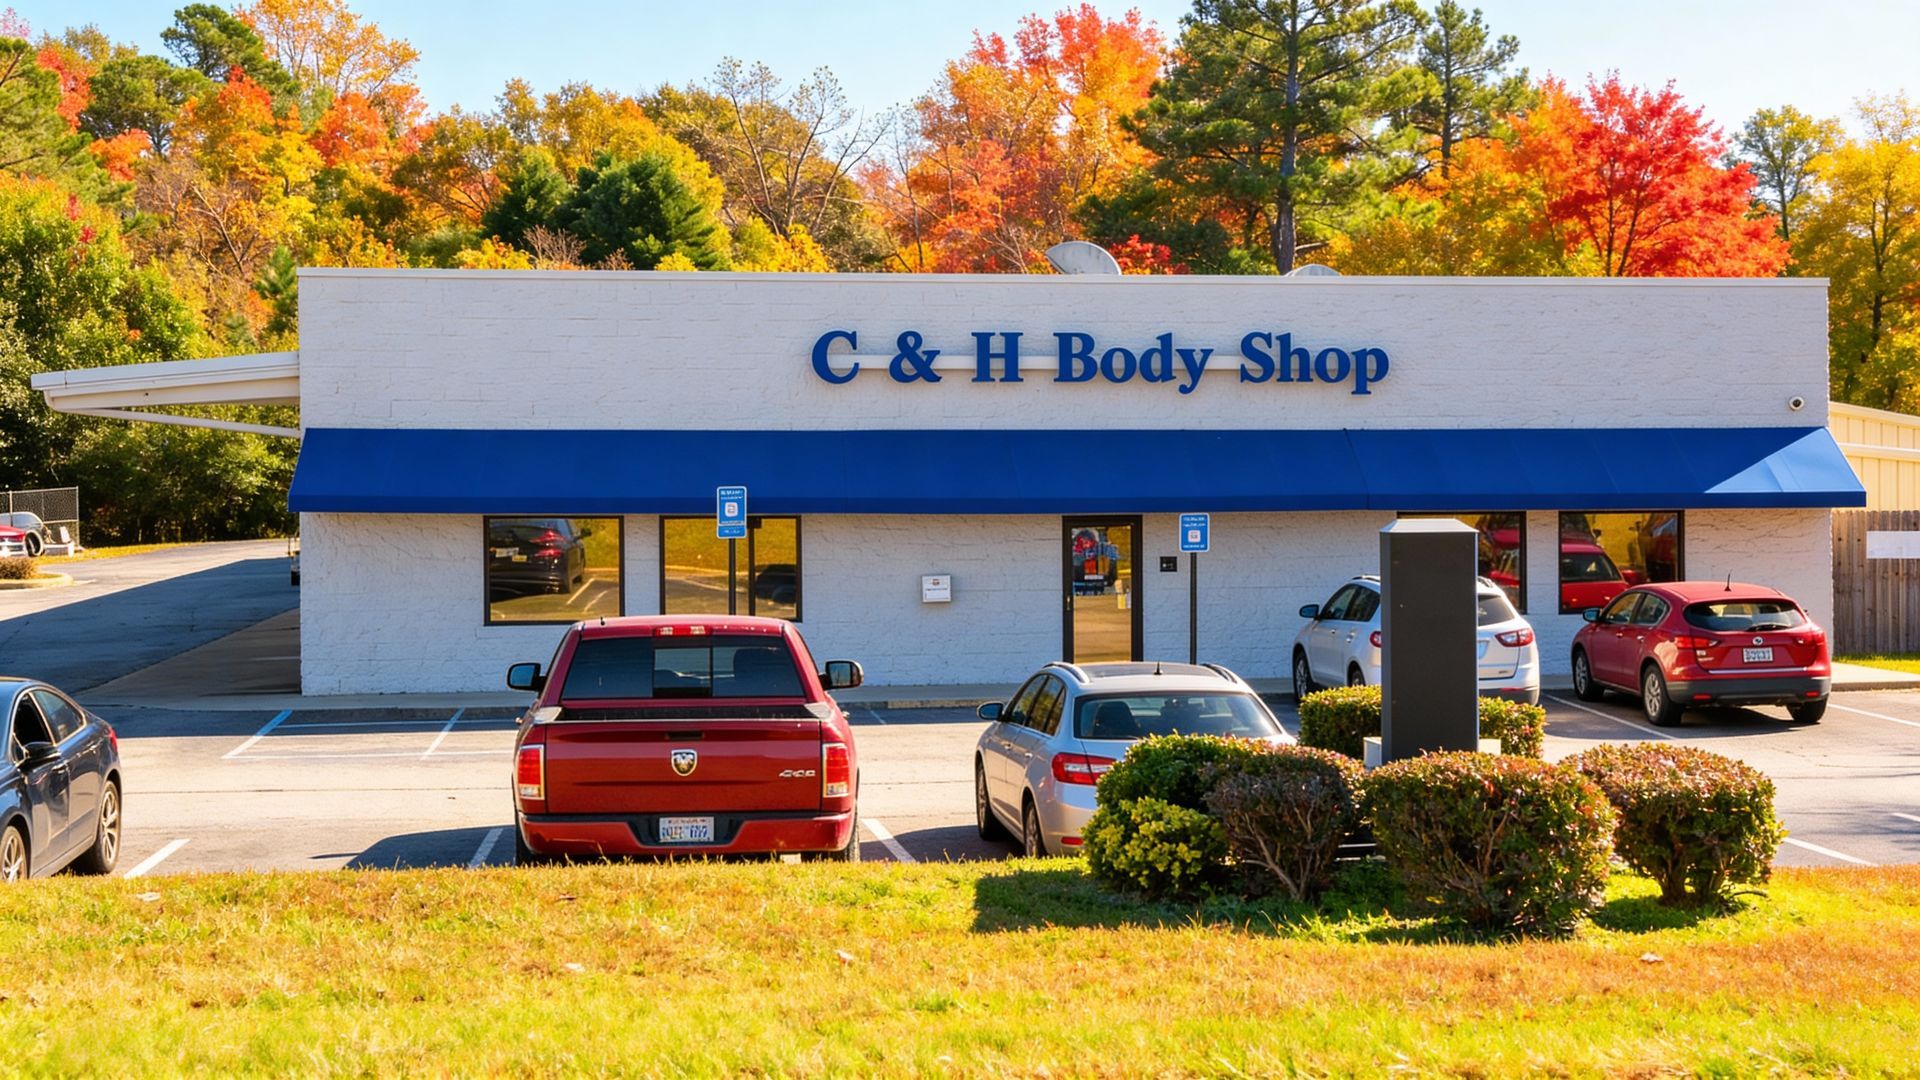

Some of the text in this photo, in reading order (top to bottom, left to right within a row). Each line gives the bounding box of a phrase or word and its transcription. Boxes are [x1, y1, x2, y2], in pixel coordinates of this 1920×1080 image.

[811, 330, 1390, 395] C & H Body Shop
